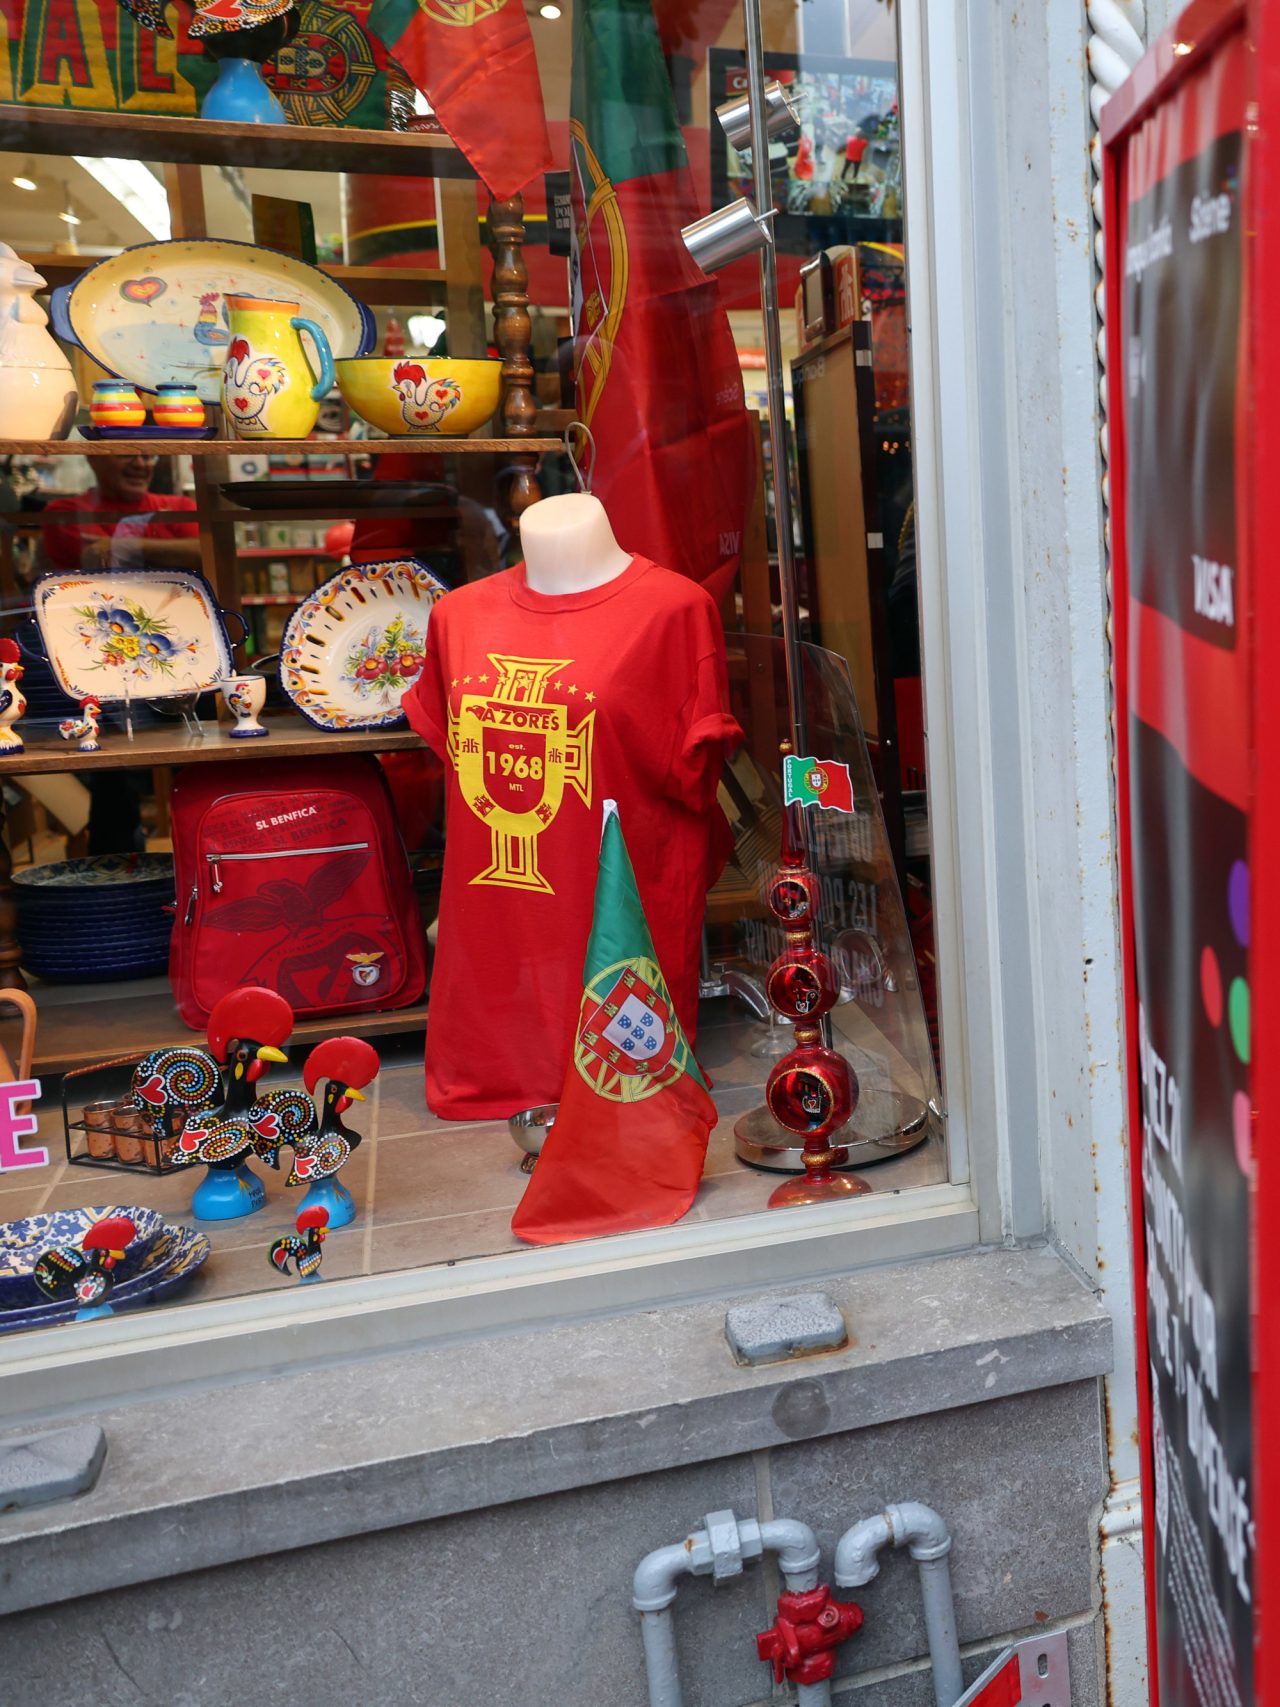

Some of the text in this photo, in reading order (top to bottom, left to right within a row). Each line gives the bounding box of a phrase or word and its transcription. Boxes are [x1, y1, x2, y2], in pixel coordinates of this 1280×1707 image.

[480, 706, 560, 731] AZORES
[508, 743, 526, 751] est.
[486, 751, 543, 781] 1968
[508, 782, 525, 792] MTL
[255, 820, 270, 831] SL
[270, 806, 318, 827] BENFICA
